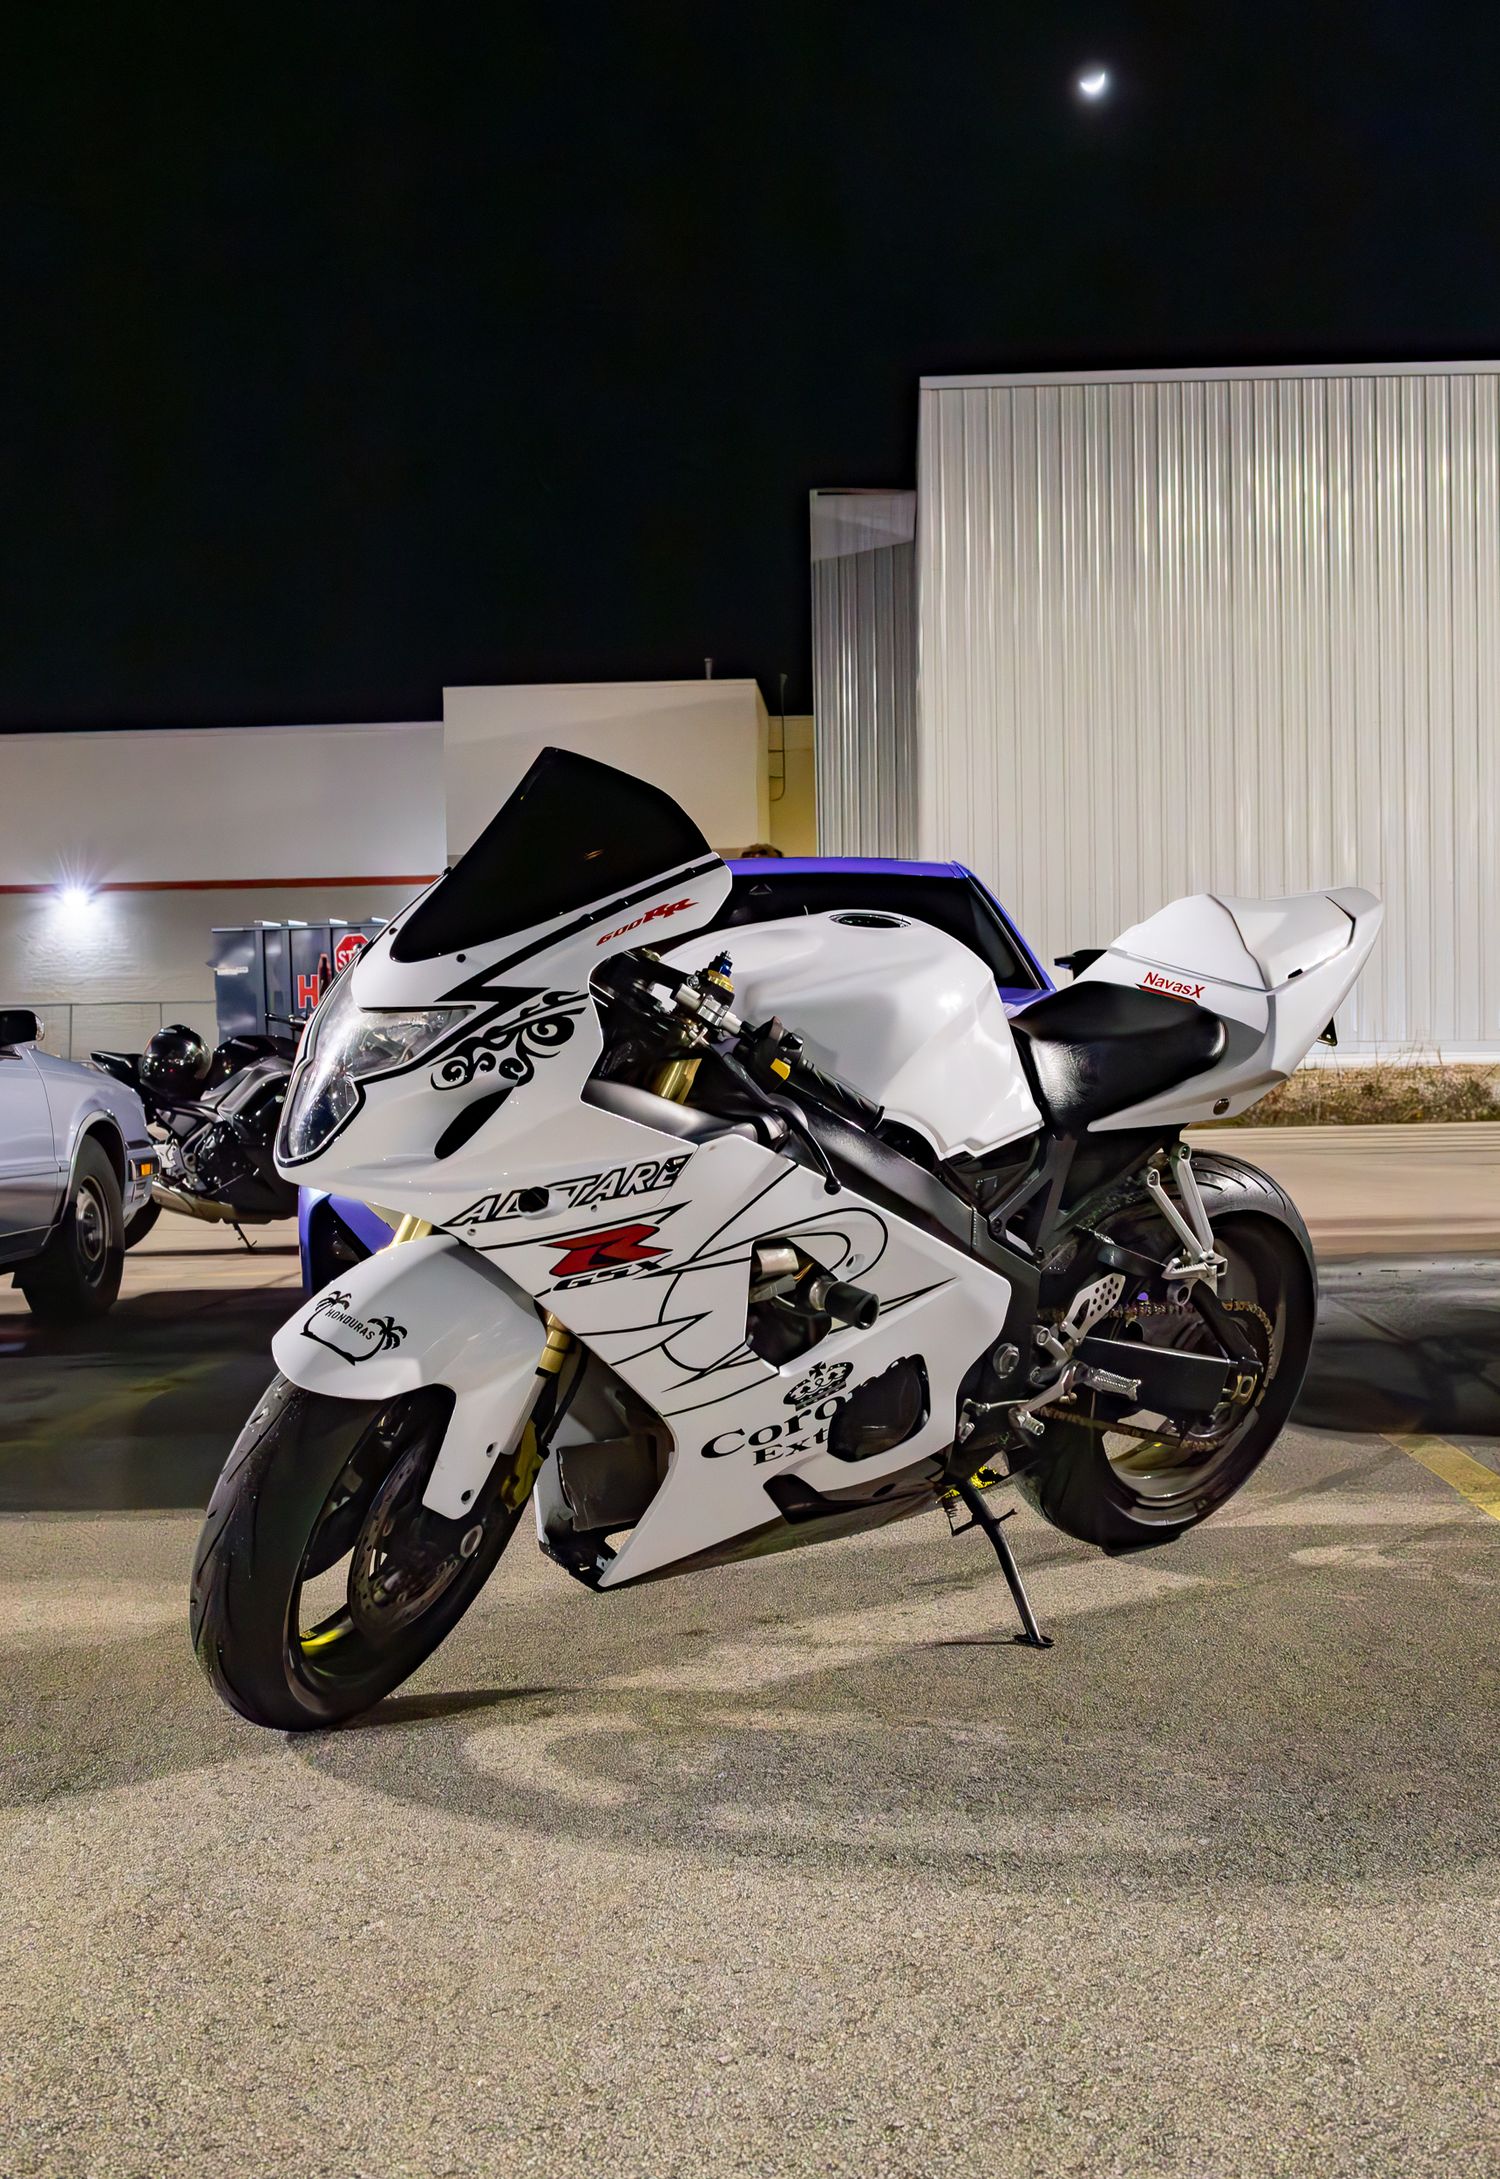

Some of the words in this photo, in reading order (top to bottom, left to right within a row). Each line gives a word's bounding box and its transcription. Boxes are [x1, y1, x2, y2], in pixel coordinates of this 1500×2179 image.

[596, 898, 699, 946] 600RR
[1143, 971, 1206, 999] NavasX
[438, 1152, 693, 1227] ALTARE
[552, 1253, 673, 1291] GSX
[324, 1308, 375, 1340] HONDURAS
[701, 1396, 847, 1459] Coro
[752, 1427, 829, 1466] Ext
